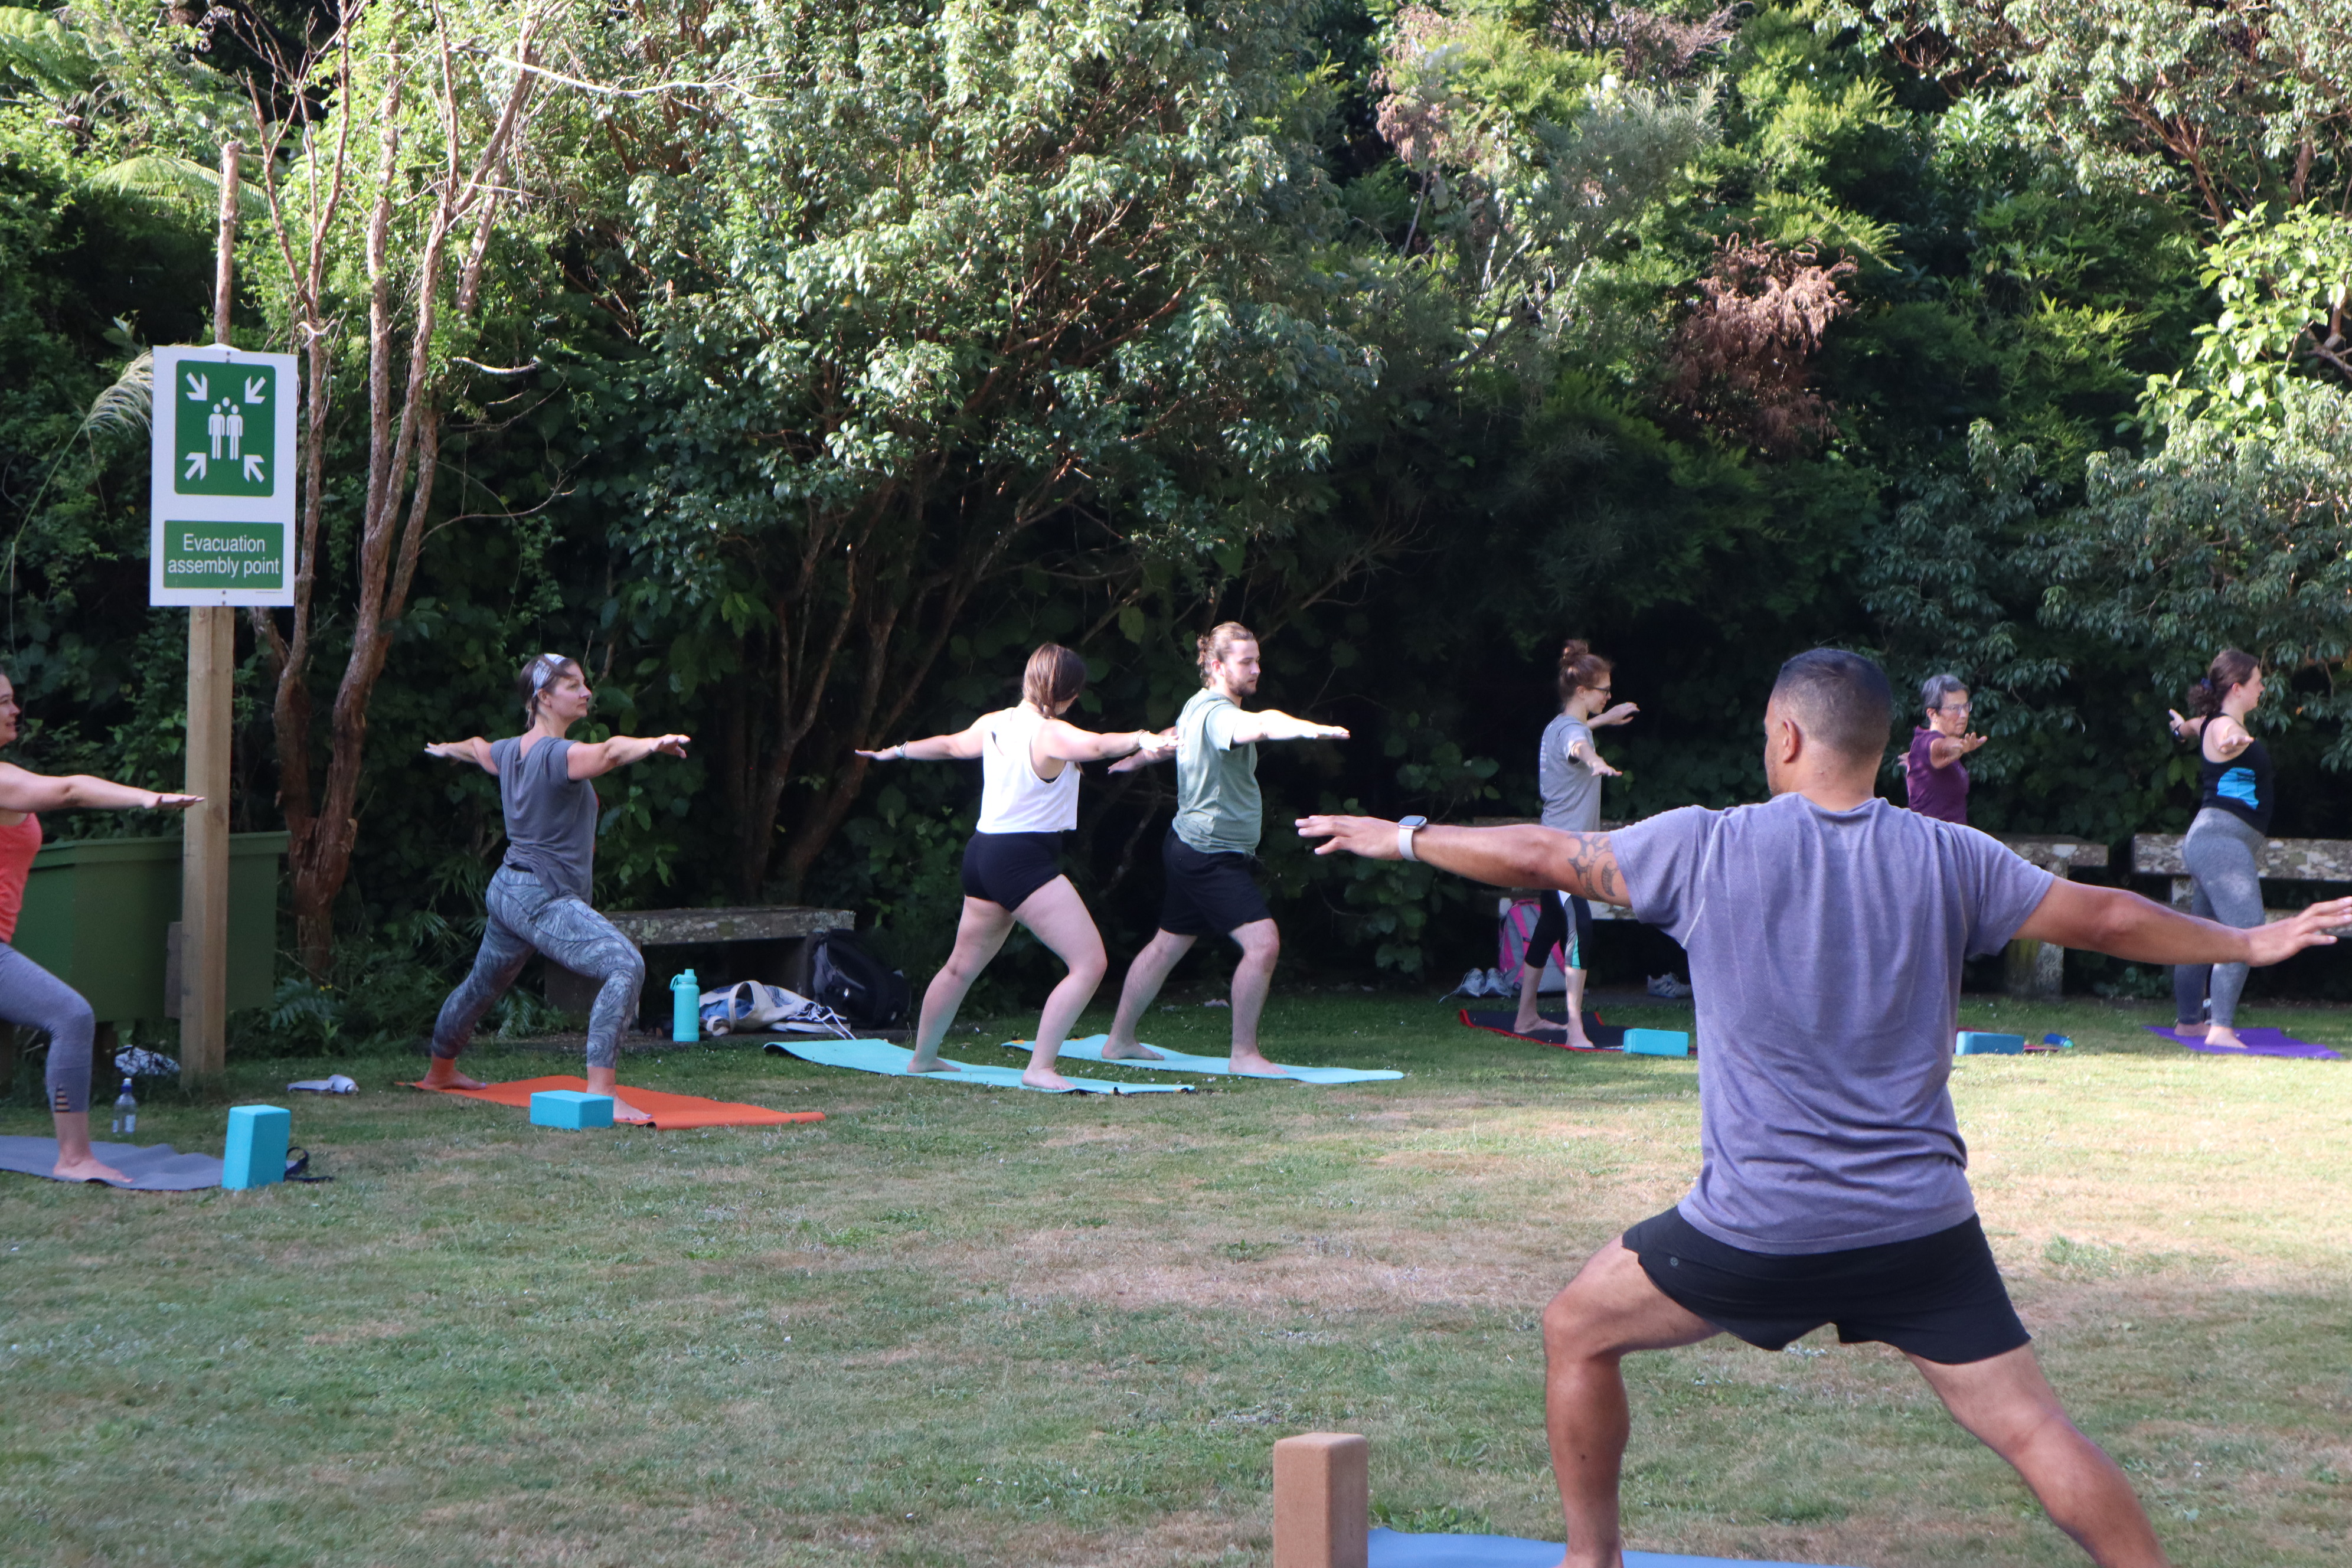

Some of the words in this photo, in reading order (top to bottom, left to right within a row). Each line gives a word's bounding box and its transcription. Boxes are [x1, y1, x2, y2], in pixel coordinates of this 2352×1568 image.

[184, 533, 265, 553] Evacuation
[168, 556, 239, 578] assembly
[244, 557, 279, 578] point
